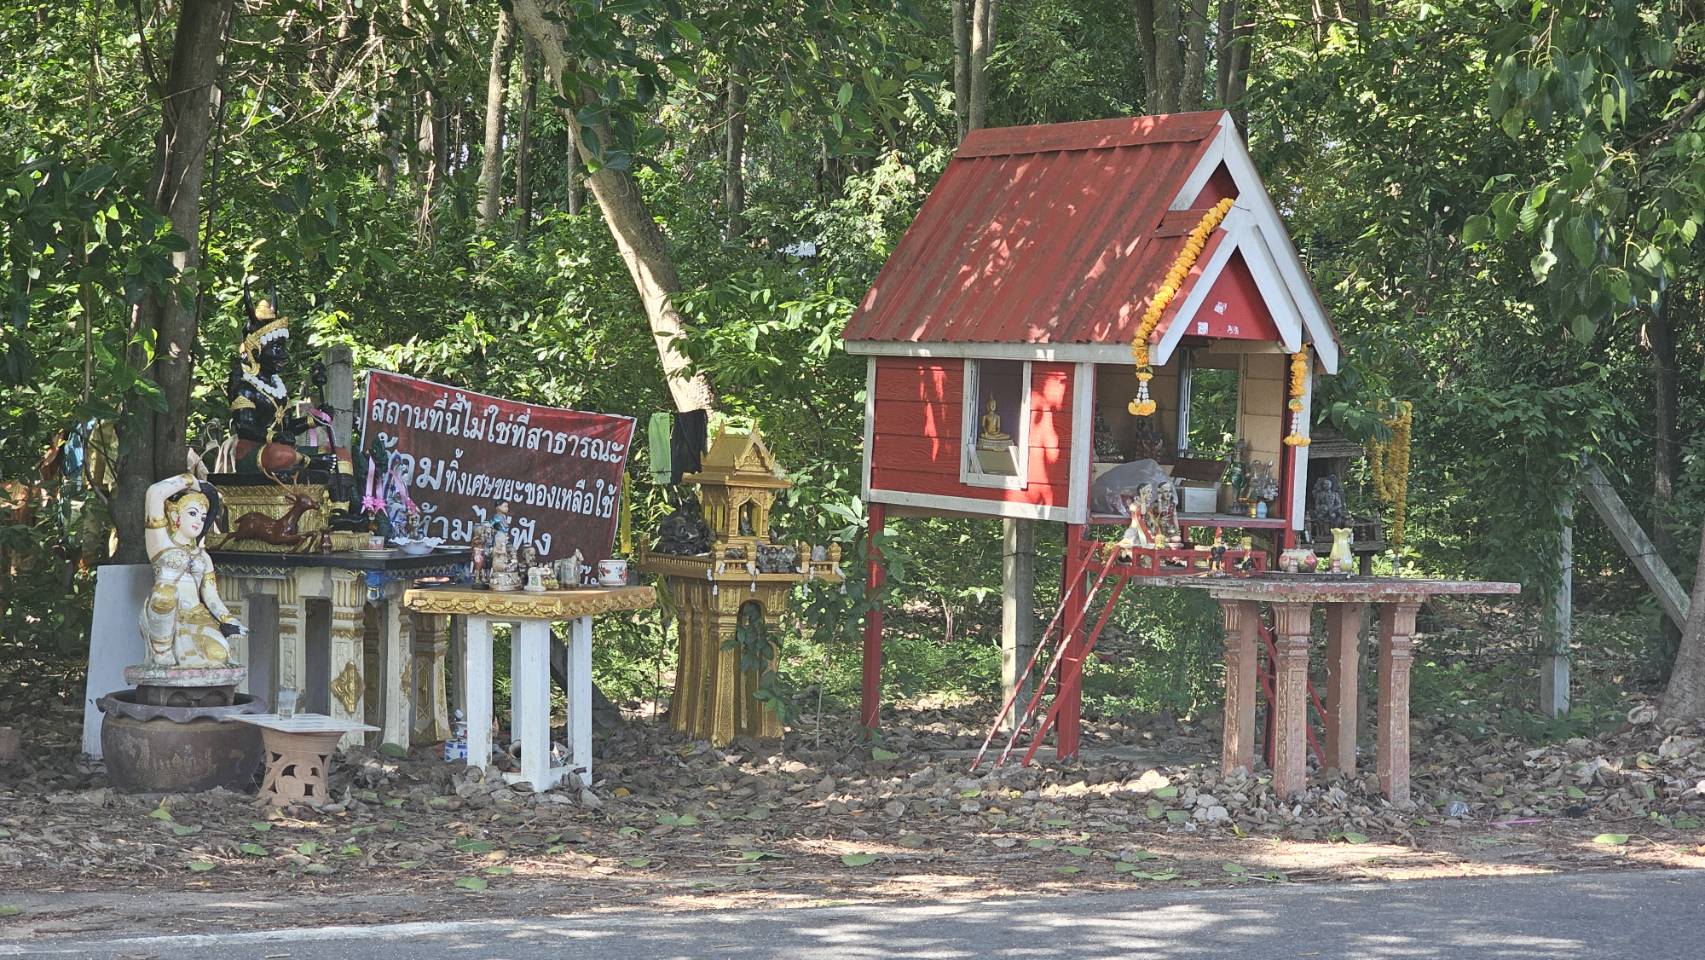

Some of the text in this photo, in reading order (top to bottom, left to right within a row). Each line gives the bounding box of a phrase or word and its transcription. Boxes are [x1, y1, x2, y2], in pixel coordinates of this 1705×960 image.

[371, 393, 625, 464] สถานที่นี้ไม่ใช่ที่สาธารณะ
[377, 431, 618, 519] ้ามทิ้งเศษขยะของเหลือใช้
